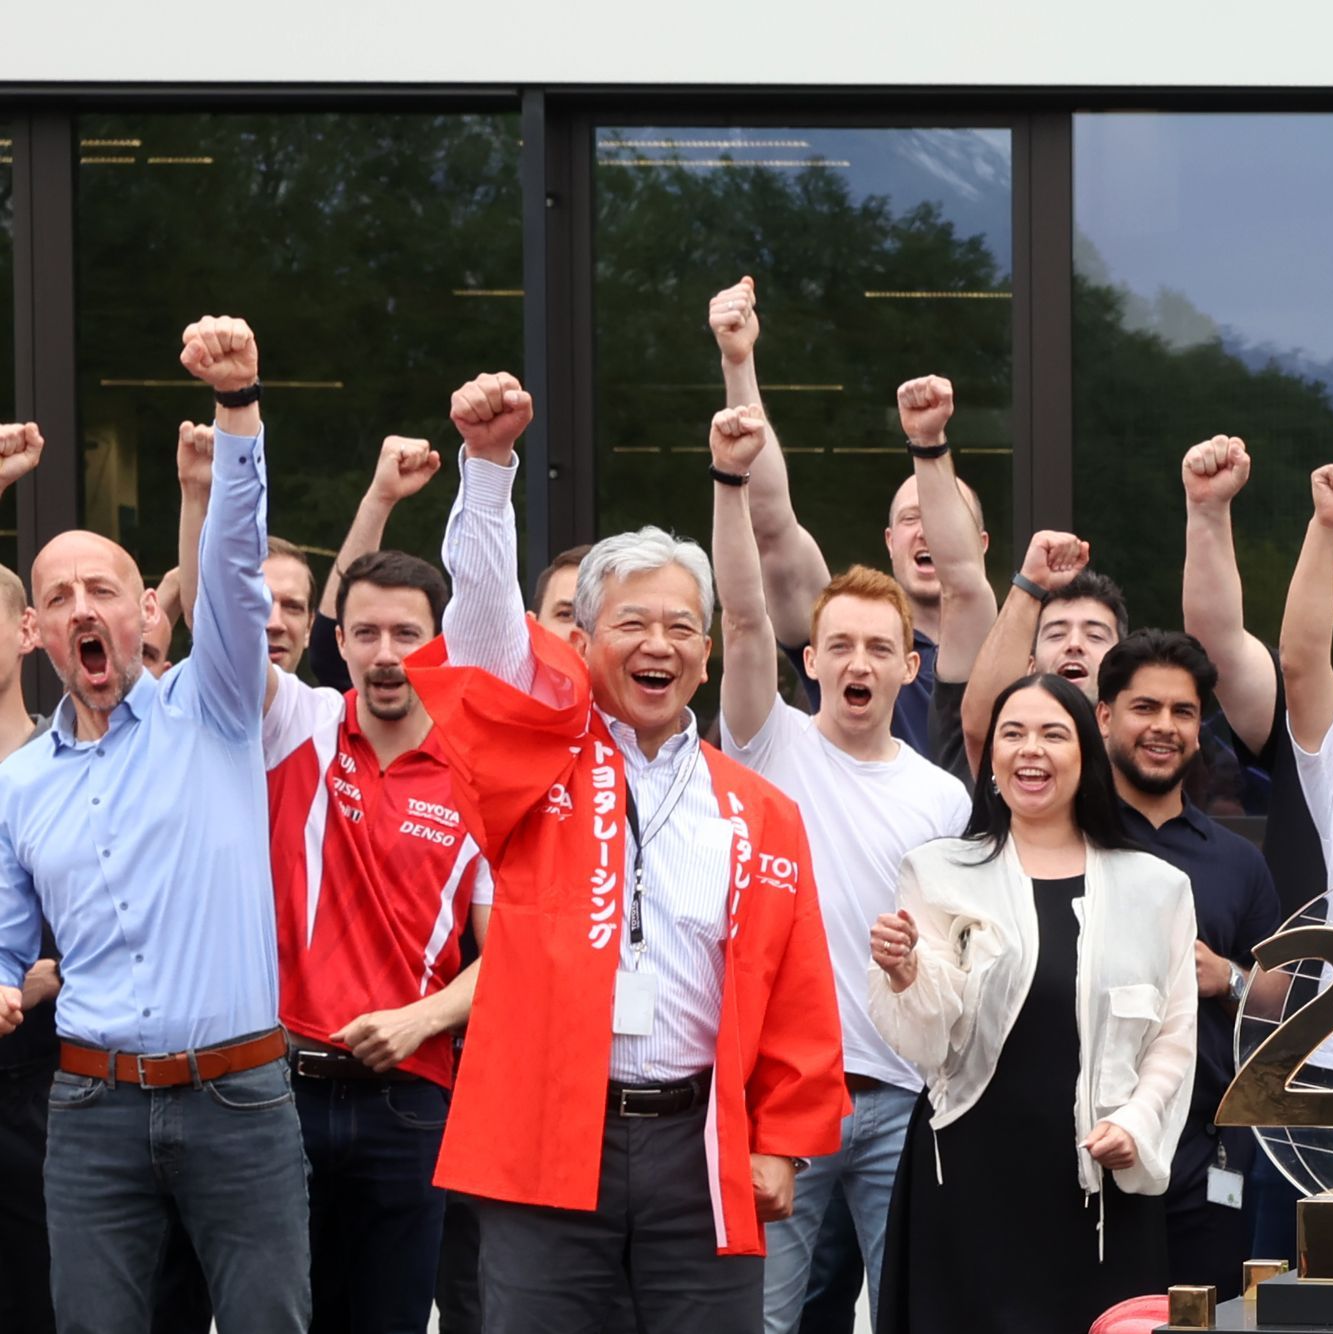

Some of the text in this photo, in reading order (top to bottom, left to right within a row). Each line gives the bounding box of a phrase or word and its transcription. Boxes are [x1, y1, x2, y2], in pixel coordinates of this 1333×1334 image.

[408, 798, 460, 824] TOYOTA
[400, 821, 455, 847] DENSO
[588, 740, 617, 949] トヨタレーシング
